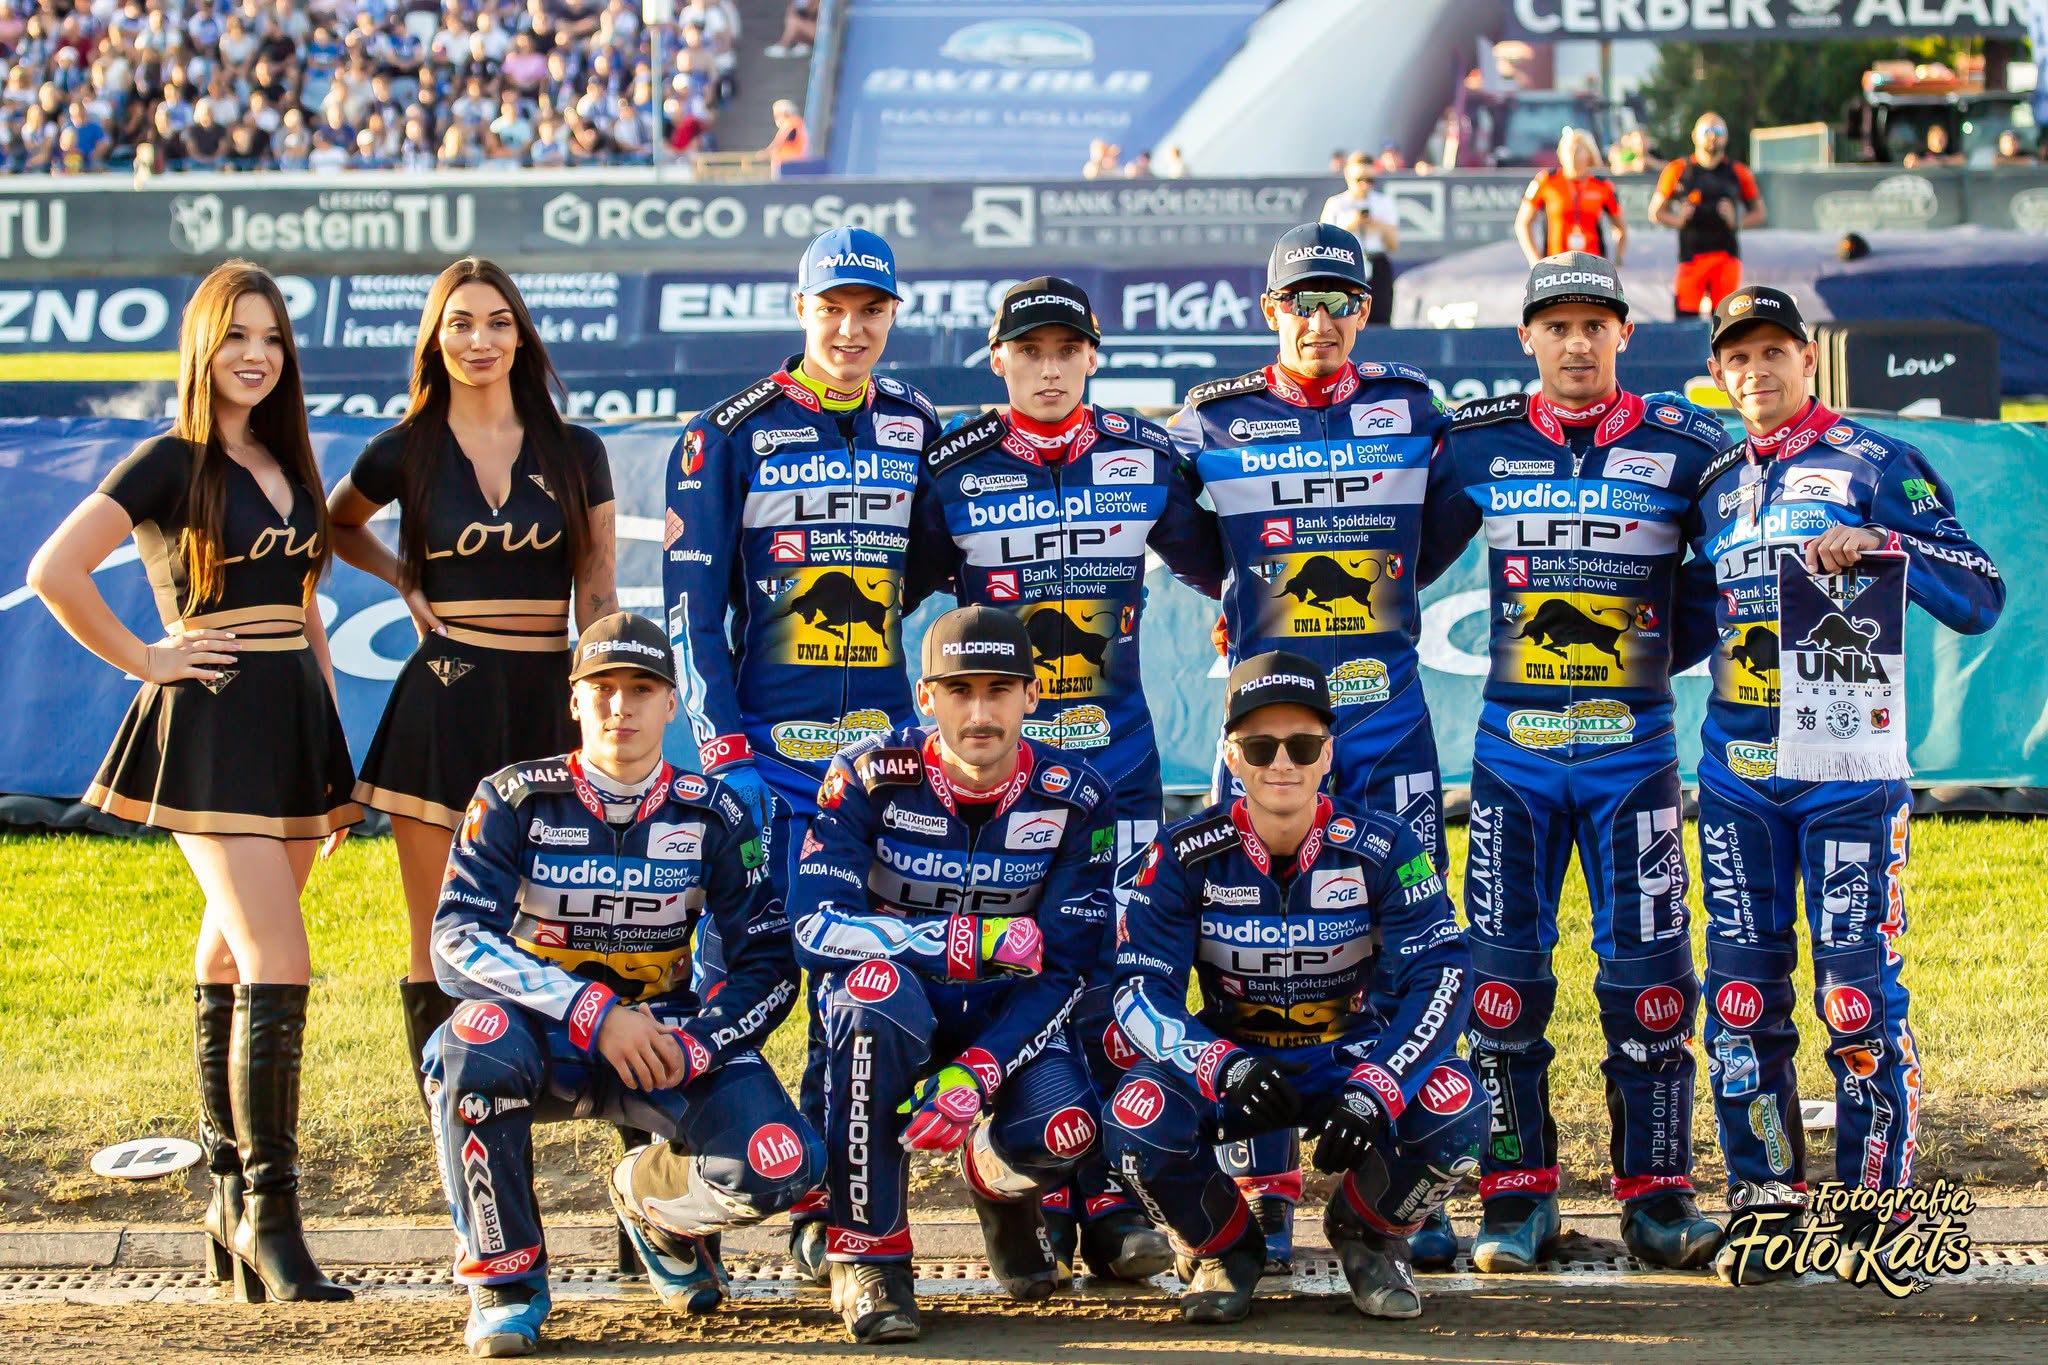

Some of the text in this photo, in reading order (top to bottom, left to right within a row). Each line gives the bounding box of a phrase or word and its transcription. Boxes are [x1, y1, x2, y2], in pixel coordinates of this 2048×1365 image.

[1514, 0, 1776, 33] CERBER
[1041, 189, 1115, 214] BANK
[226, 195, 475, 253] JestemTU
[597, 197, 748, 240] RCGO
[1283, 245, 1355, 266] GARCAREK
[1534, 271, 1614, 292] POLCOPPER
[1010, 294, 1086, 316] POLCOPPER
[1122, 279, 1252, 331] FIGA
[1359, 366, 1386, 377] Gulf
[1192, 374, 1267, 400] CANAL+
[715, 379, 776, 428] CANAL+
[1452, 399, 1520, 422] CANAL+
[1102, 417, 1130, 432] Gulf
[1249, 419, 1299, 432] FLIXHOME
[1367, 417, 1394, 429] PGE
[1655, 409, 1682, 422] Gulf
[769, 427, 817, 440] FLIXHOME
[888, 431, 915, 443] PGE
[1141, 426, 1169, 443] QMEX
[1695, 420, 1722, 438] QMEX
[1827, 427, 1853, 441] Gulf
[927, 420, 999, 466] CANAL+
[1357, 443, 1389, 454] DOMY
[1860, 438, 1889, 458] QMEX
[881, 457, 915, 472] DOMY
[1241, 443, 1354, 473] budio.pl
[1358, 453, 1404, 463] GOTOWE
[1508, 460, 1554, 471] FLIXHOME
[1699, 443, 1746, 485] CANAL+
[760, 453, 878, 486] budio.pl
[1108, 466, 1138, 478] PGE
[1619, 464, 1655, 478] PGE
[978, 474, 1027, 486] FLIXHOME
[1800, 484, 1831, 496] PGE
[1094, 491, 1132, 502] DOMY
[1271, 475, 1369, 506] LFP
[1490, 483, 1608, 513] budio.pl
[1612, 488, 1650, 502] DOMY
[794, 491, 892, 522] LFP
[968, 489, 1092, 527] budio.pl
[1095, 502, 1147, 513] GOTOWE
[1611, 500, 1666, 514] GOTOWE
[1791, 510, 1826, 520] DOMY
[1296, 513, 1396, 529] Bank Spółdzielczy
[810, 530, 910, 551] Bank Spółdzielczy
[1296, 531, 1369, 545] we Wschowie
[1517, 519, 1621, 547] LFP
[810, 549, 888, 563] we Wschowie
[1000, 529, 1106, 563] LFP
[1022, 562, 1138, 583] Bank Spółdzielczy
[1532, 557, 1653, 580] Bank Spółdzielczy
[1024, 583, 1107, 599] we Wschowie
[1532, 575, 1617, 591] we Wschowie
[1733, 587, 1761, 600] Bank
[1737, 606, 1749, 616] we
[1294, 616, 1366, 633] UNIA LESZNO
[797, 643, 829, 661] UNIA
[942, 641, 1016, 657] POLCOPPER
[1526, 663, 1555, 680] UNIA
[1796, 652, 1891, 684] UNIA
[1240, 674, 1315, 696] POLCOPPER
[1738, 685, 1759, 701] UNIA
[1796, 687, 1892, 698] LESZNO
[1340, 692, 1388, 705] ROJĘCZYN
[1516, 715, 1622, 731] AGROMIX
[1796, 715, 1817, 731] 38
[497, 766, 570, 802] CANAL+
[675, 781, 706, 797] Gulf
[1042, 771, 1070, 787] Gulf
[720, 792, 745, 822] QMEX
[896, 809, 947, 829] FLIXHOME
[542, 826, 589, 839] FLIXHOME
[1020, 829, 1055, 844] PGE
[1329, 824, 1355, 838] Gulf
[665, 842, 698, 853] PGE
[1244, 832, 1267, 865] Fogo
[1302, 828, 1323, 864] Fogo
[876, 838, 1000, 883] budio.pl
[1004, 861, 1045, 873] DOMY
[1470, 799, 1494, 938] ALMAR
[531, 857, 652, 889] budio.pl
[654, 866, 690, 878] DOMY
[799, 863, 863, 889] DUDA Holding
[461, 893, 497, 912] Holding
[900, 882, 1013, 914] LFP
[1210, 886, 1260, 899] FLIXHOME
[1326, 887, 1358, 903] PGE
[558, 893, 662, 919] LFP
[572, 923, 688, 942] Bank Spółdzielczy
[1201, 917, 1314, 946] budio.pl
[1318, 918, 1356, 931] DOMY
[572, 942, 592, 951] we
[1116, 952, 1138, 966] DUDA
[1231, 950, 1329, 974] LFP
[850, 966, 893, 993] Alm
[1248, 979, 1280, 992] Bank
[1477, 989, 1514, 1021] Alm
[1644, 994, 1680, 1023] Alm
[1721, 988, 1756, 1018] Alm
[1831, 995, 1867, 1023] Alm
[459, 1007, 500, 1037] Alm
[710, 978, 797, 1050] POLCOPPER
[1388, 966, 1463, 1077] POLCOPPER
[1422, 1072, 1466, 1107] Alm
[1116, 1083, 1155, 1121] Alm
[848, 1035, 874, 1225] POLCOPPER
[1651, 1081, 1667, 1169] AUTO FRELIK
[1669, 1079, 1681, 1167] Mercedes-Benz
[1054, 1118, 1095, 1154] Alm
[1763, 1100, 1784, 1169] AGROMIX
[111, 1146, 178, 1170] 14
[757, 1132, 800, 1171] Alm
[488, 1201, 503, 1252] EXPERT
[483, 1252, 531, 1275] Fogo
